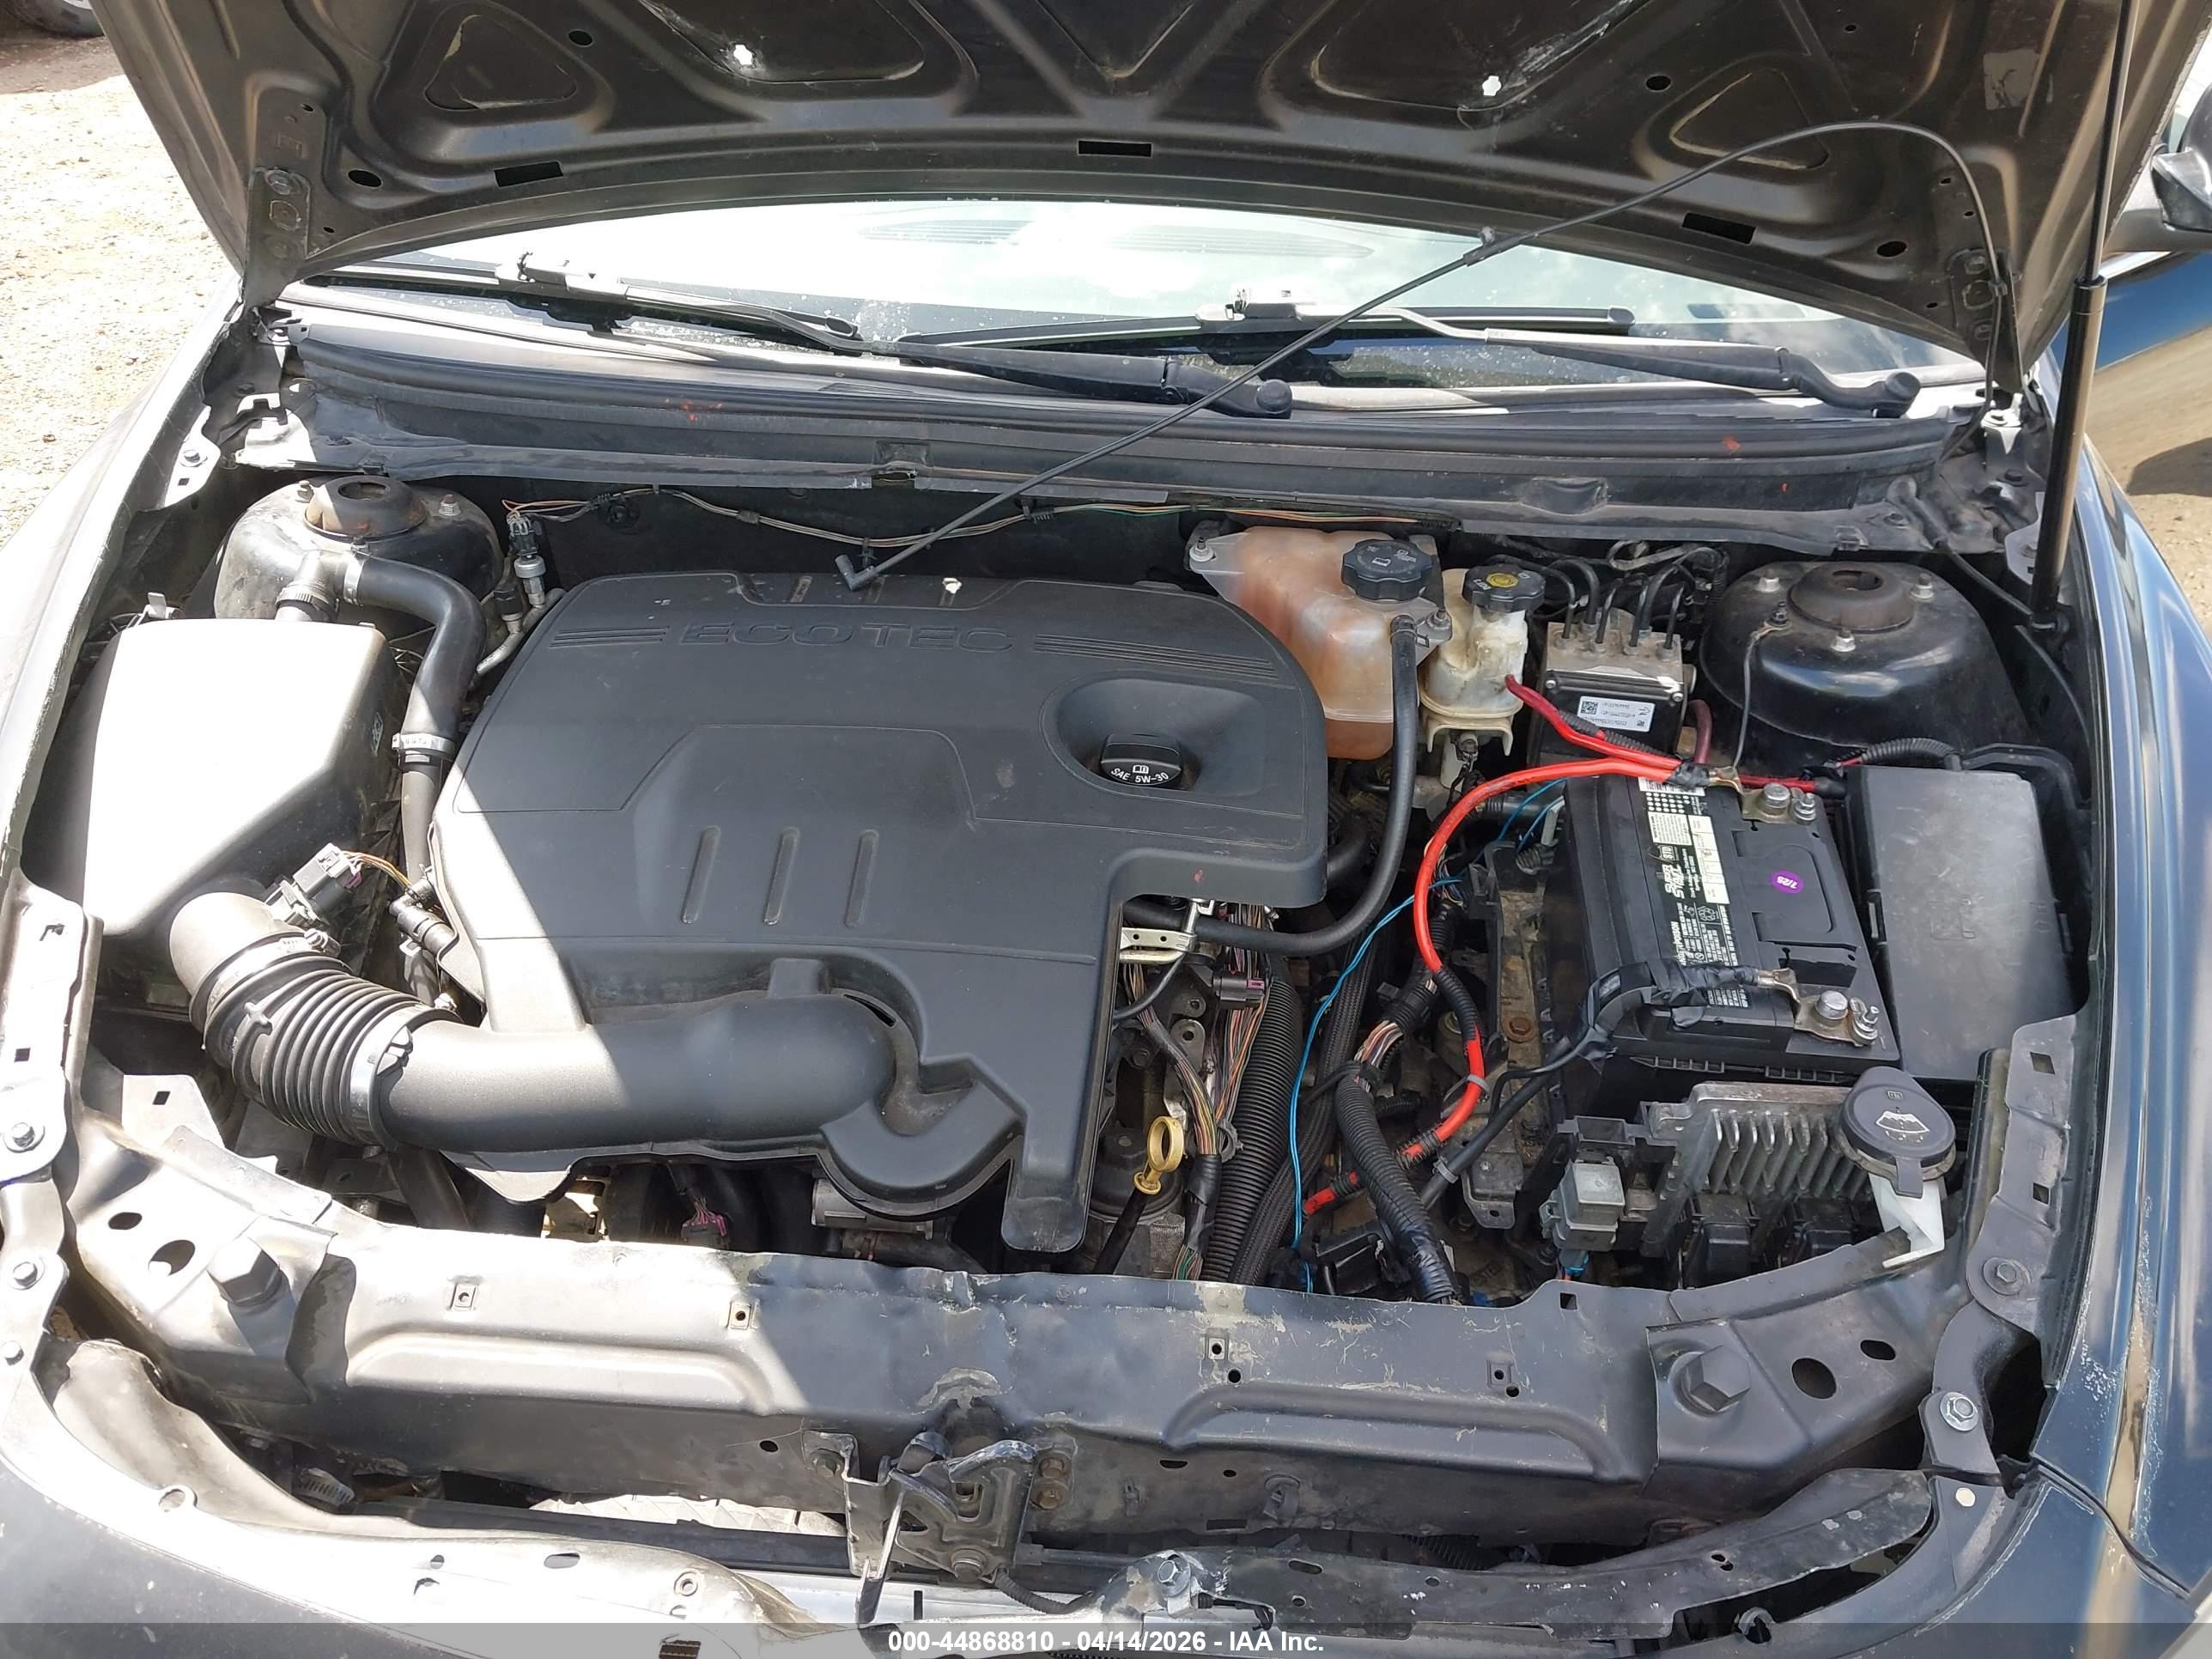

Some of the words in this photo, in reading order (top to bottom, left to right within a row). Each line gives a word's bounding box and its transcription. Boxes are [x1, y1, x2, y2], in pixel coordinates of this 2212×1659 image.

[679, 621, 1017, 654] ECOTEC
[1110, 768, 1132, 781] SAE
[1134, 771, 1170, 784] 5W-30
